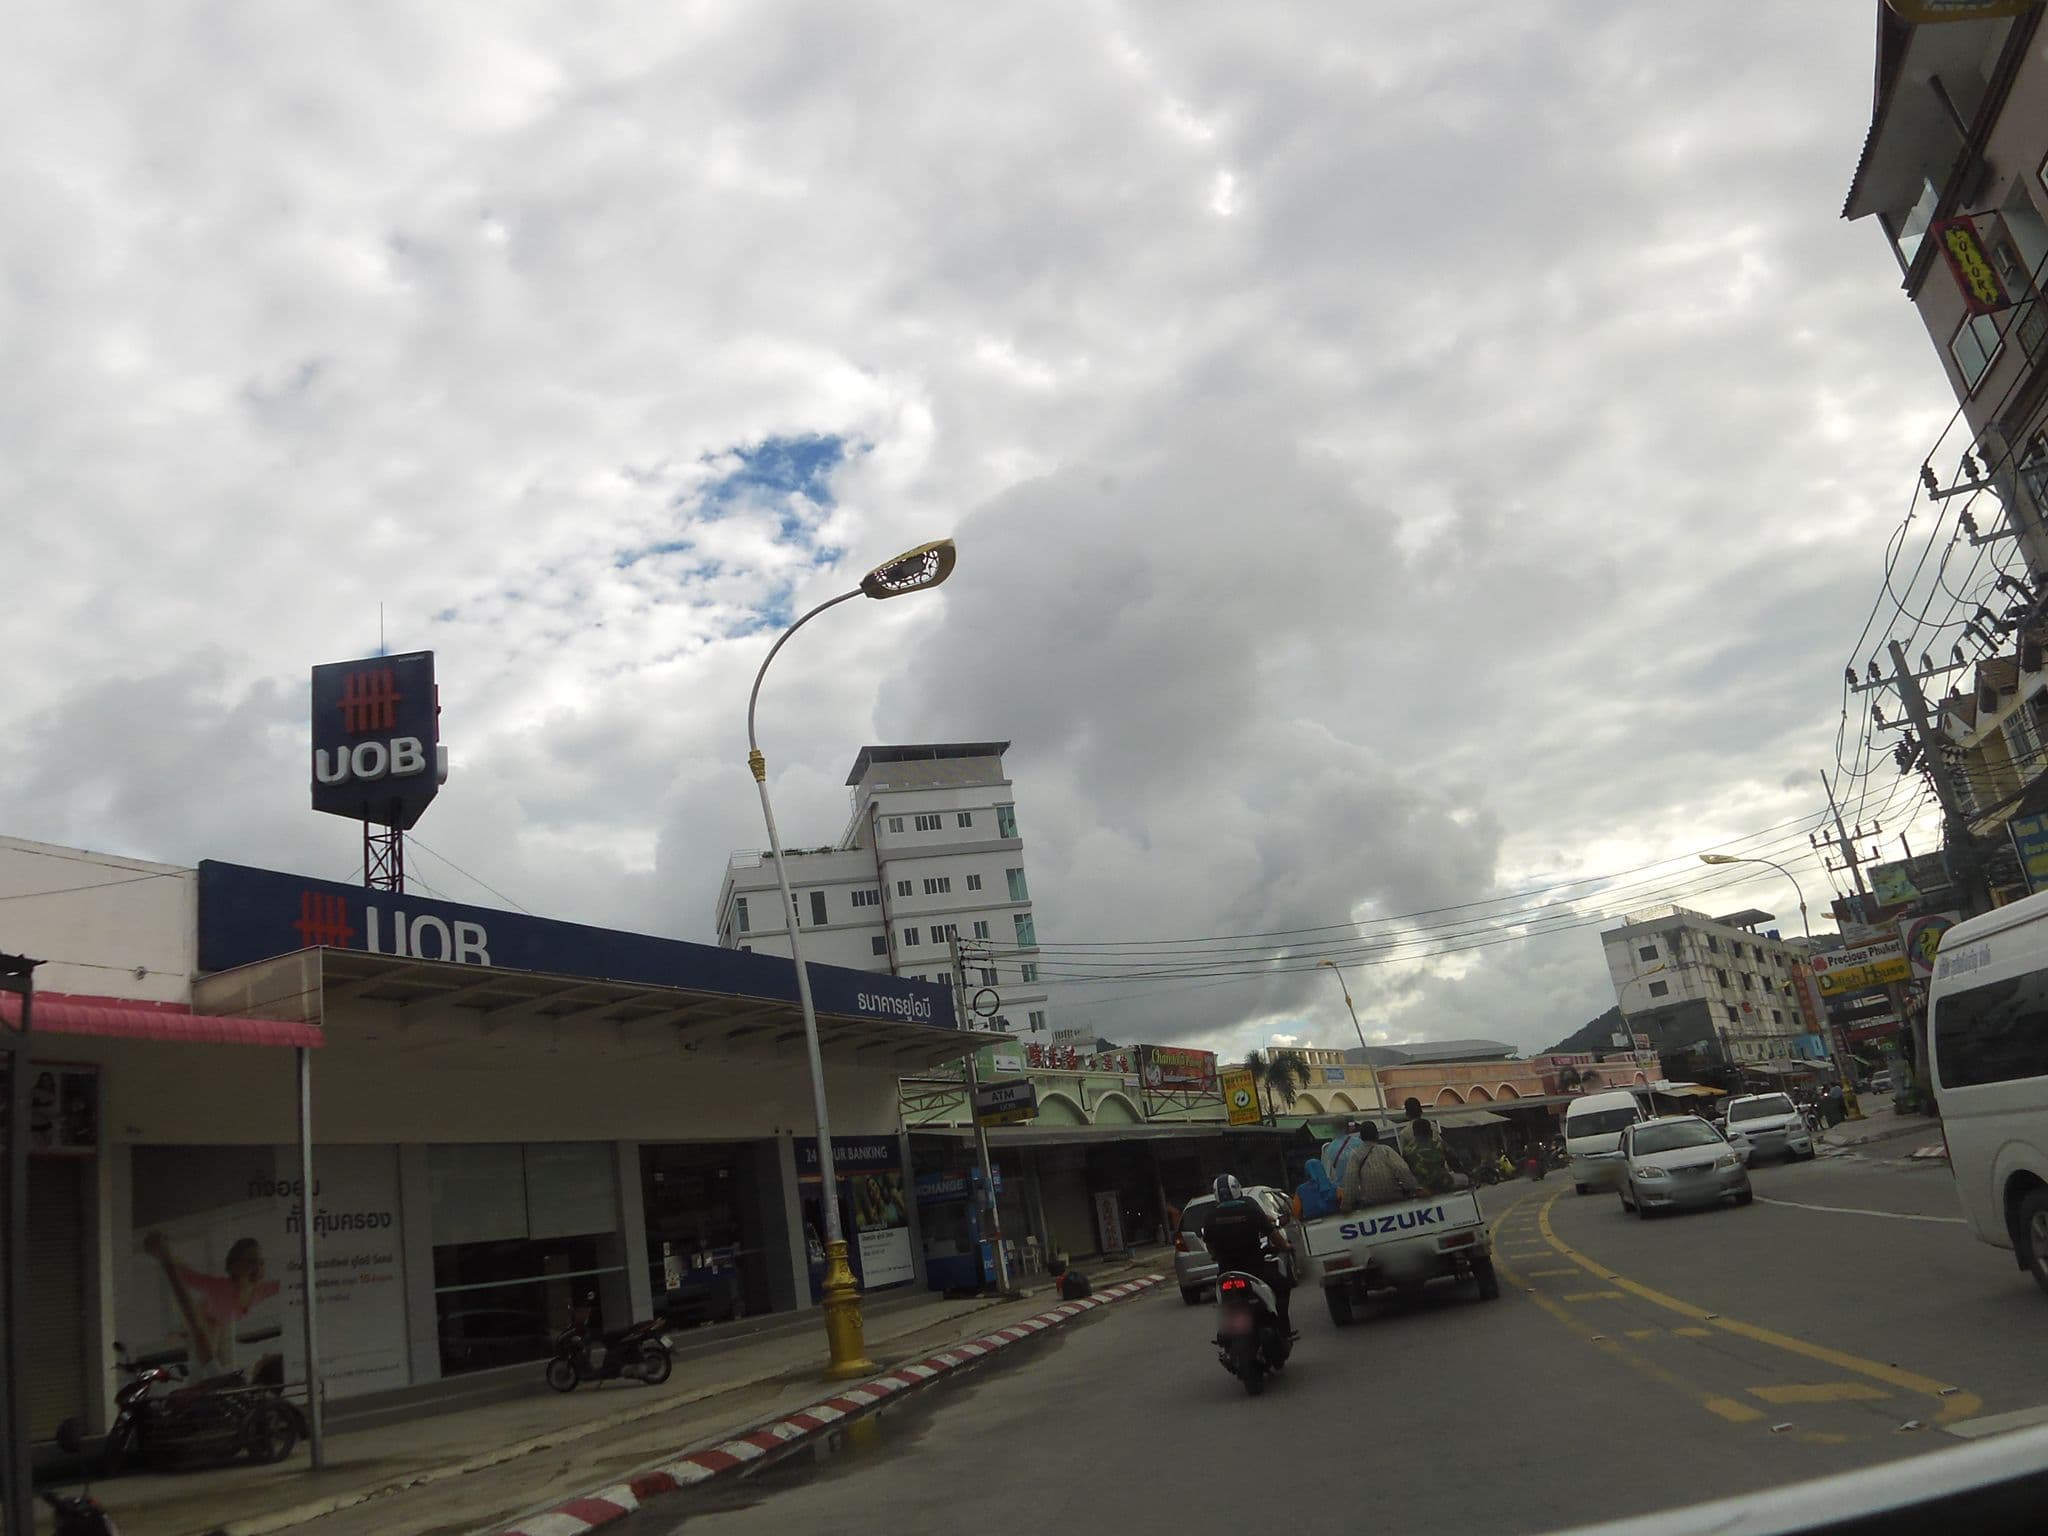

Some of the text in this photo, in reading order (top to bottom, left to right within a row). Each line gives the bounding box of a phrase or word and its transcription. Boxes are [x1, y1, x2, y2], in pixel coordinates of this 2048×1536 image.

[315, 736, 426, 784] UOB
[366, 906, 492, 967] UOB
[1827, 951, 1868, 967] Precious
[1868, 942, 1901, 957] Phuket
[858, 993, 931, 1022] ธนาคารยูโอบี
[991, 1089, 1015, 1103] ATM
[848, 1145, 888, 1161] BANKING
[286, 1204, 392, 1239] ทั้คุ้มครอง
[1339, 1206, 1445, 1240] SUZUKI
